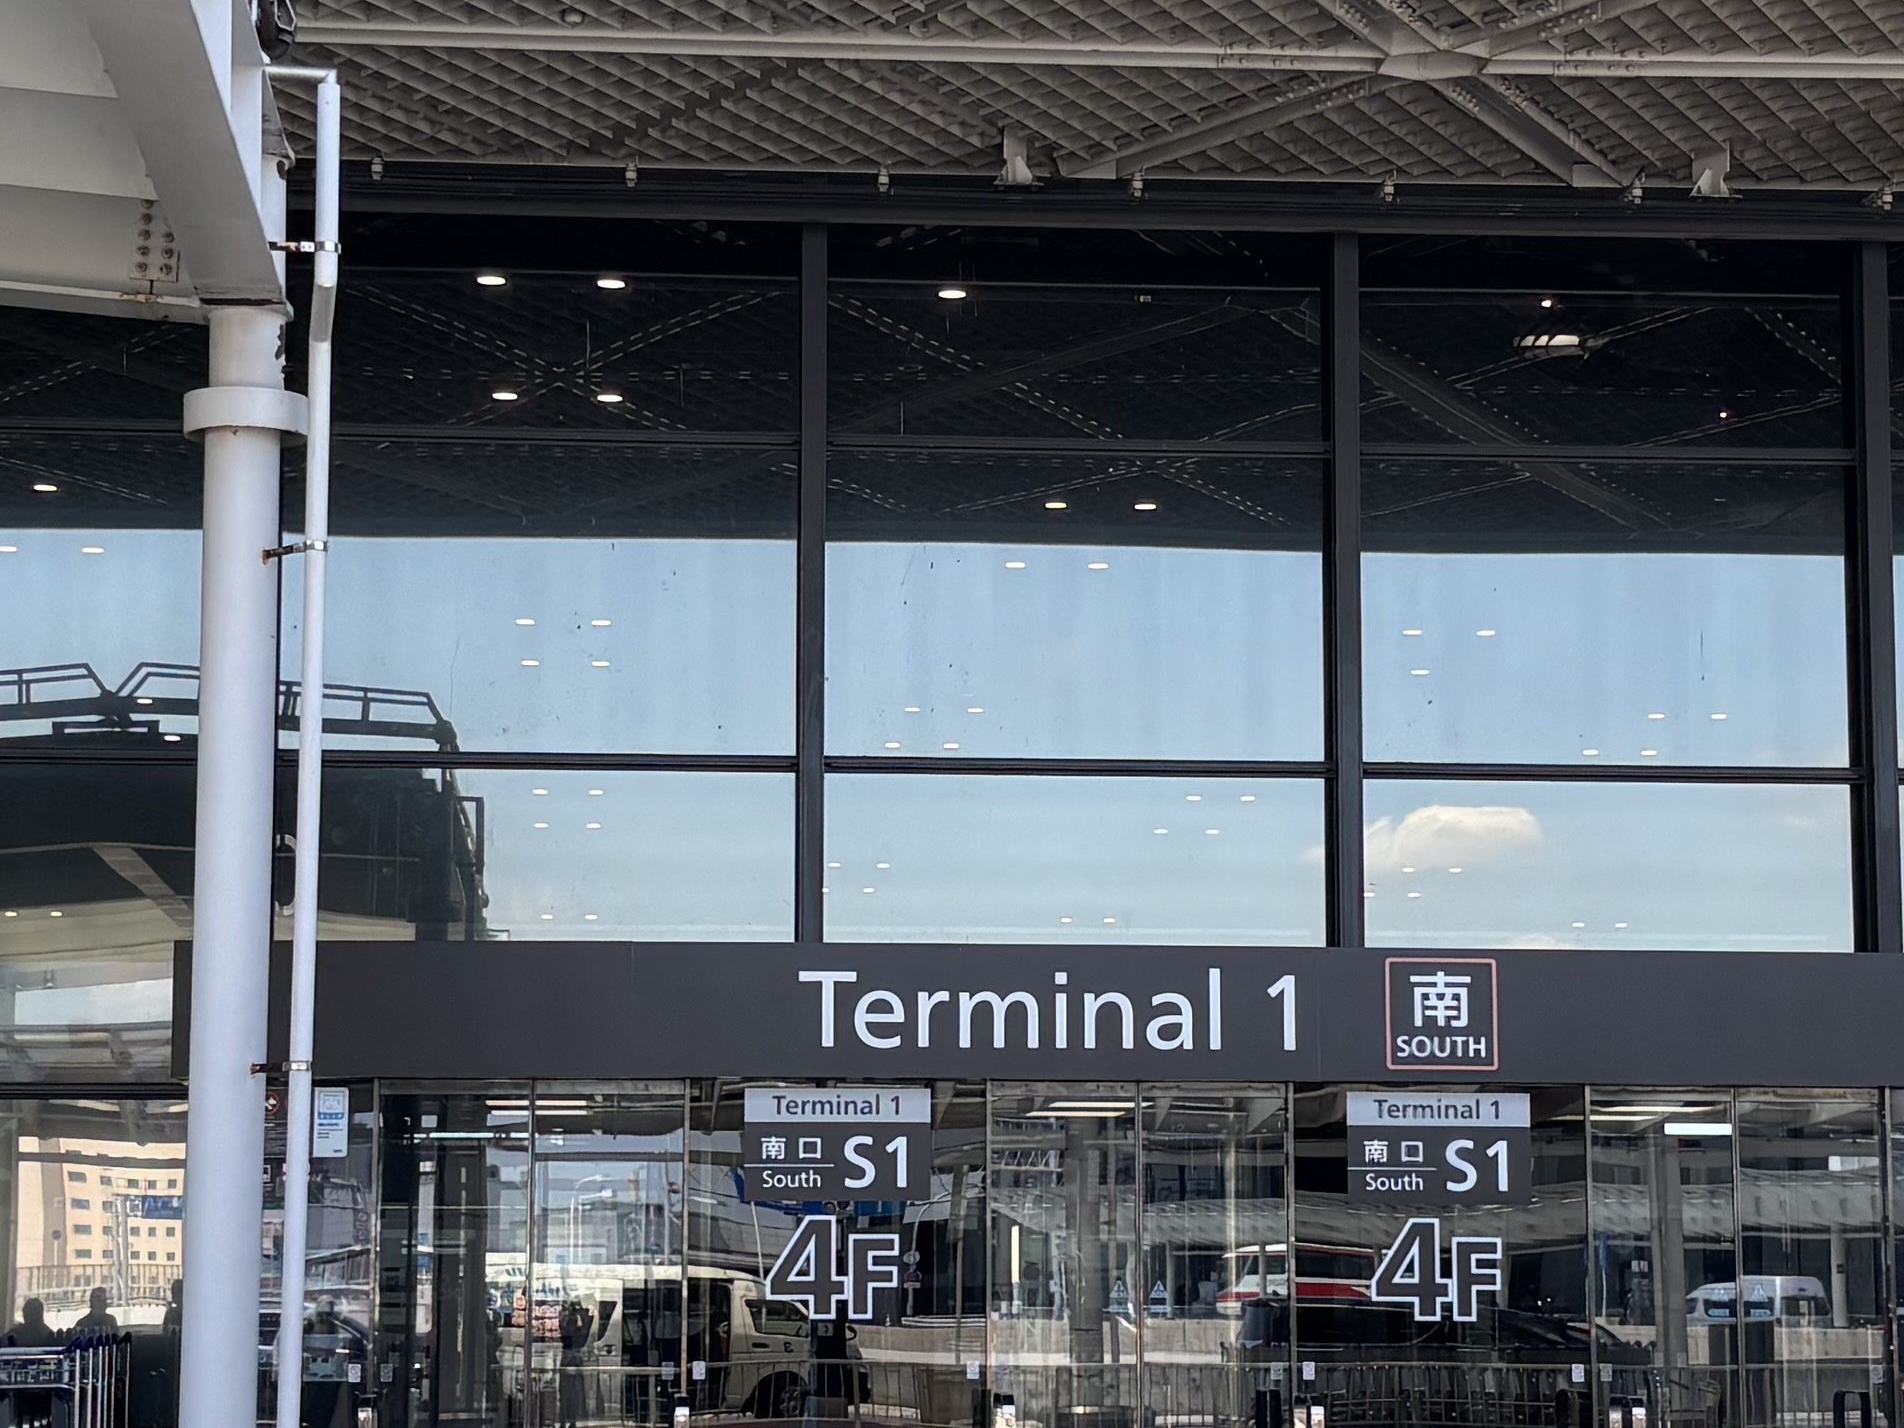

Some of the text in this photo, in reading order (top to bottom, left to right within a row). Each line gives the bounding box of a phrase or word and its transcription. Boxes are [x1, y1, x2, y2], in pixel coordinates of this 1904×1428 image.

[798, 967, 1298, 1052] Terminal 1
[1409, 970, 1473, 1029] 南
[1395, 1035, 1487, 1059] SOUTH
[771, 1093, 901, 1116] Terminal 1
[1372, 1098, 1500, 1120] Terminal 1
[760, 1136, 822, 1160] 南口
[843, 1135, 908, 1189] S1
[1445, 1139, 1509, 1192] S1
[762, 1169, 822, 1189] South
[1365, 1172, 1424, 1191] South
[765, 1214, 900, 1320] 4F
[1370, 1217, 1503, 1322] 4F
